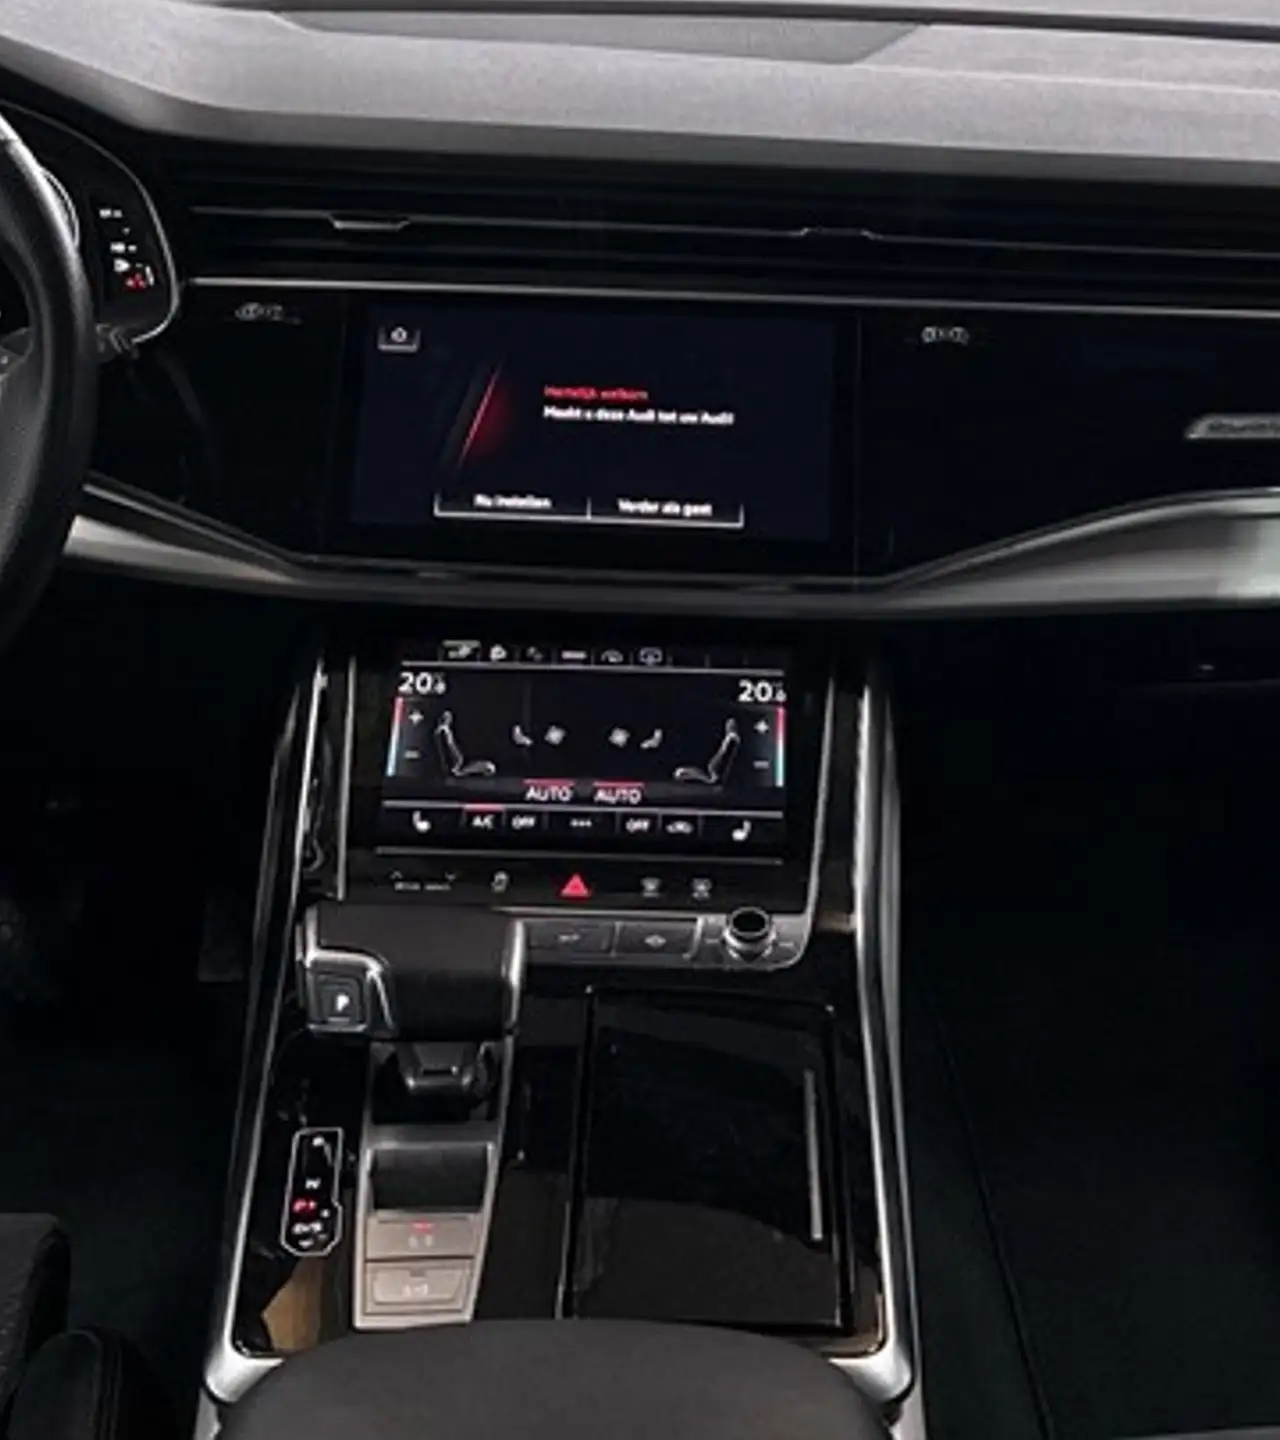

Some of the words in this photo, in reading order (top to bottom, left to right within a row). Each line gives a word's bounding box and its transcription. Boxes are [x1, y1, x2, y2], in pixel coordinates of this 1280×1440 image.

[525, 786, 572, 802] AUTO
[594, 789, 642, 804] AUTO
[511, 815, 536, 829] OFF
[336, 993, 350, 1012] P
